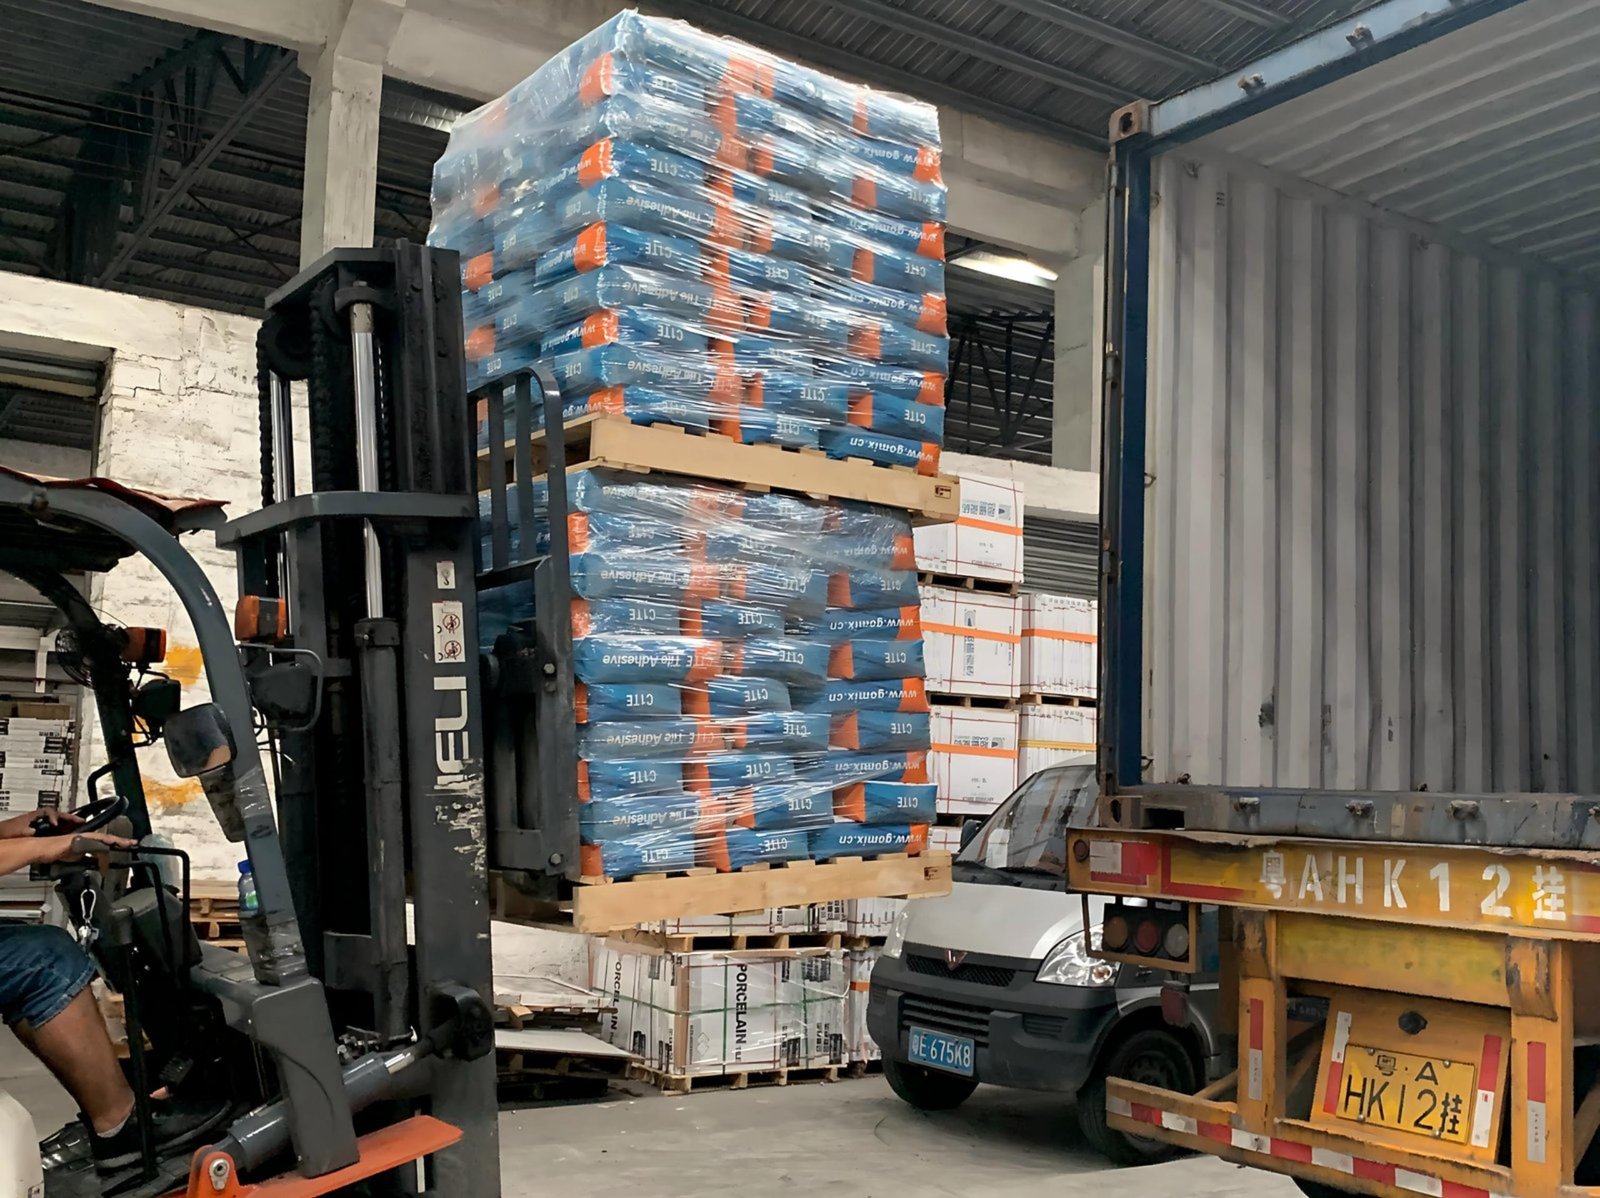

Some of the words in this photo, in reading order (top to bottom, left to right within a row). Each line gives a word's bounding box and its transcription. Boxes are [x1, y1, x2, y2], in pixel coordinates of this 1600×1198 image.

[657, 325, 684, 342] C1TE
[565, 362, 582, 378] C1TE
[800, 387, 825, 402] C1TE
[904, 409, 926, 424] C1TE
[850, 438, 935, 462] www.gomix.cn
[629, 608, 656, 621] C1TE
[737, 612, 763, 625] C1TE
[829, 617, 914, 632] www.gomix.cn
[602, 655, 659, 667] Adhesive
[884, 651, 907, 663] C1TE
[626, 693, 654, 707] C1TE
[744, 688, 769, 702] C1TE
[828, 688, 917, 704] www.gomix.cn
[889, 722, 912, 735] C1TE
[606, 733, 663, 747] Adhesive
[629, 769, 657, 784] C1TE
[745, 762, 771, 778] C1TE
[788, 798, 813, 811] C1TE
[896, 796, 918, 808] C1TE
[838, 833, 922, 847] www.gomix.cn
[735, 963, 748, 1044] PORCELAIN
